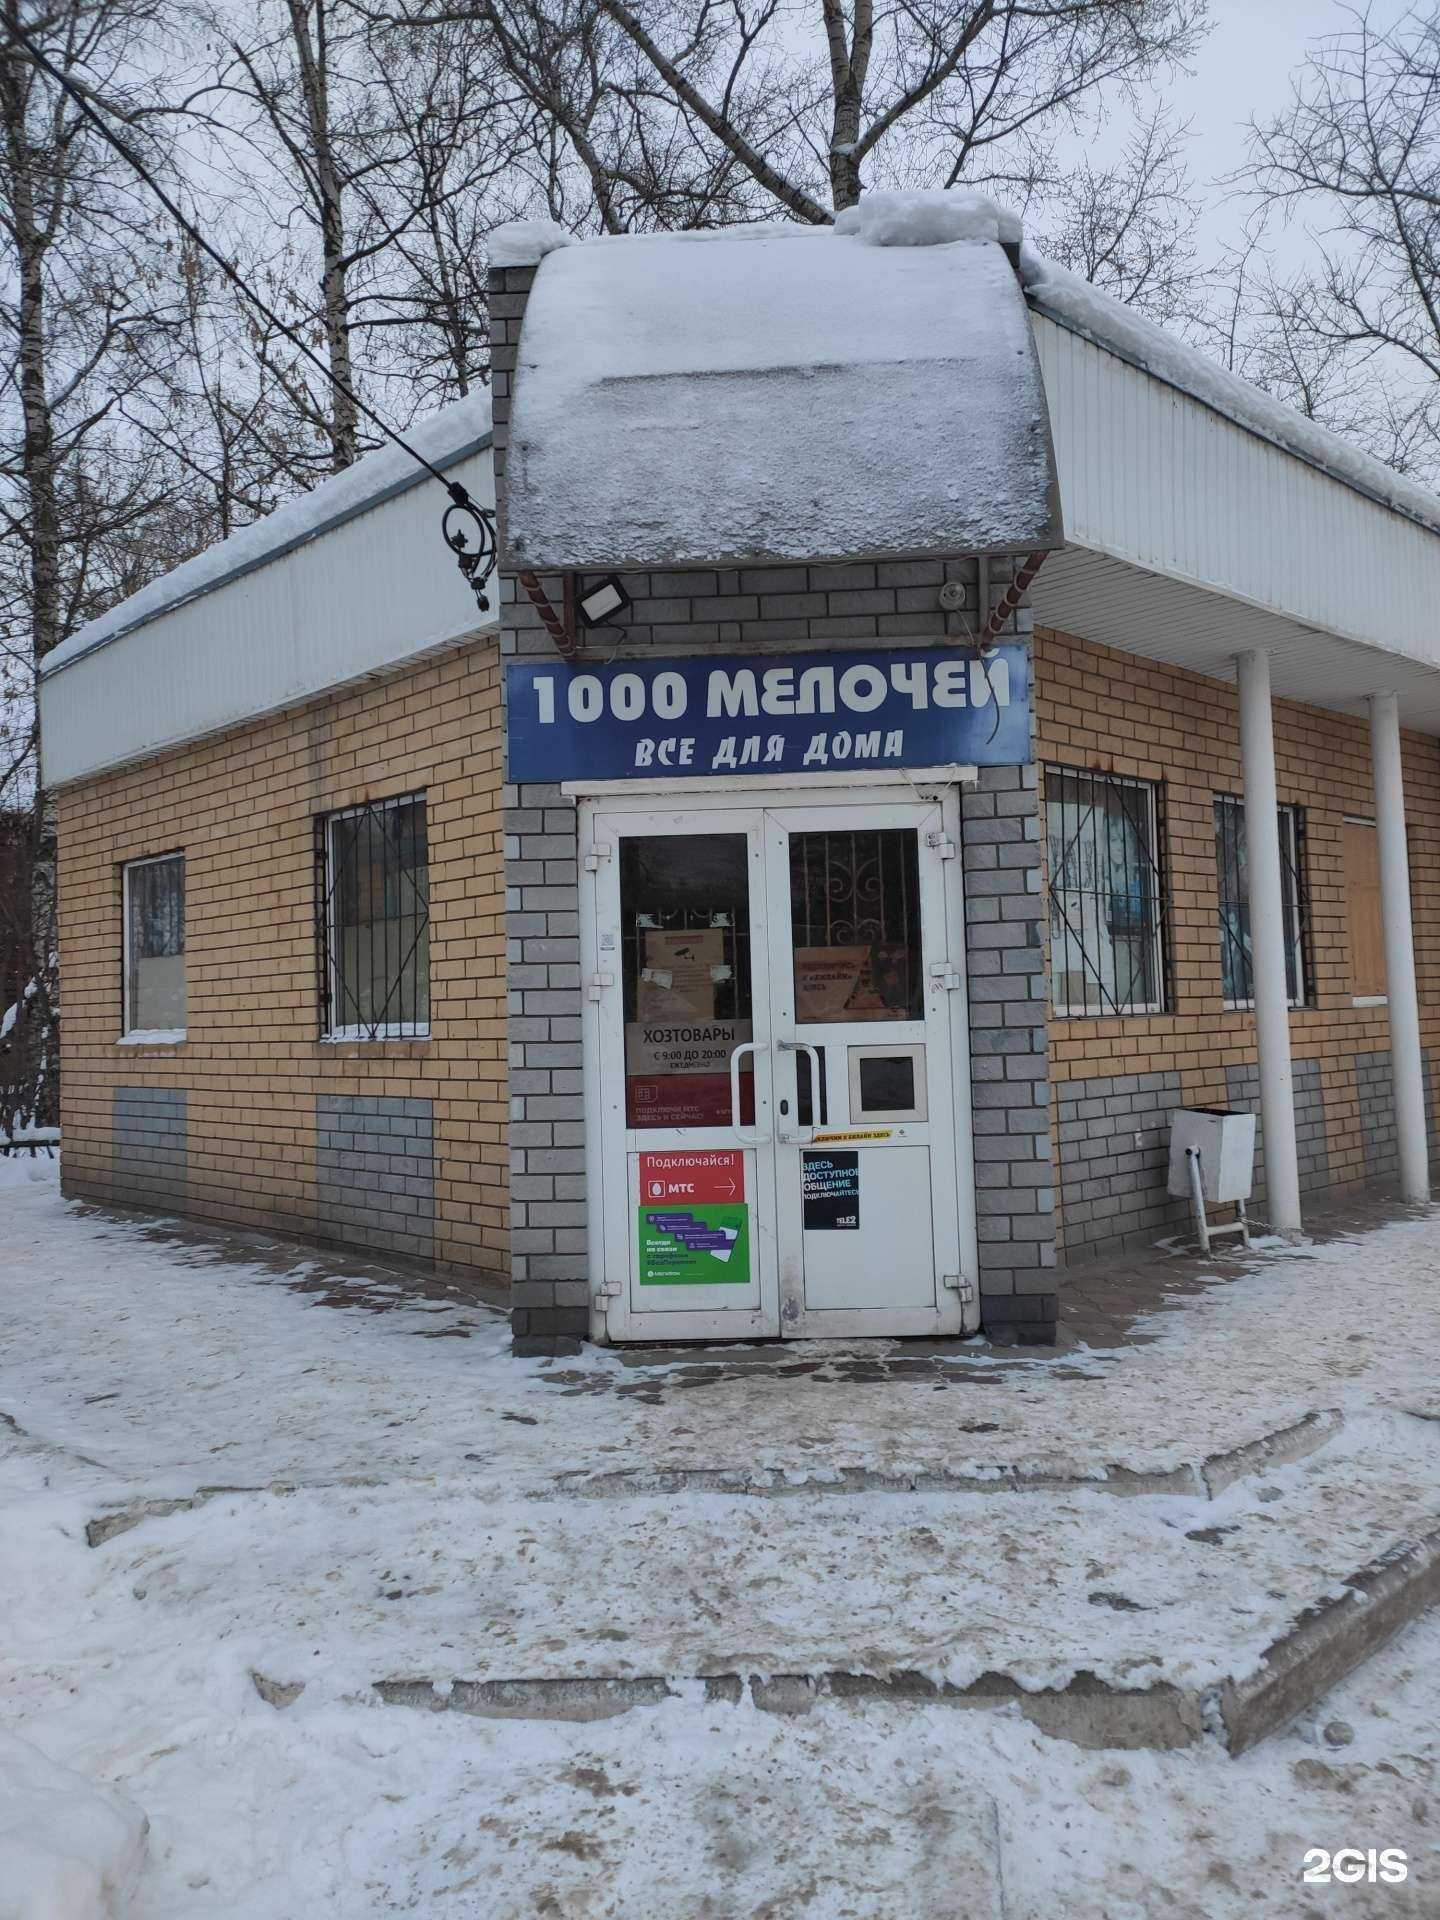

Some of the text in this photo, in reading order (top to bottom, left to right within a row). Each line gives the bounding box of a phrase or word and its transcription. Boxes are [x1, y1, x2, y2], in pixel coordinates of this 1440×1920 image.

[533, 648, 1010, 723] 1000 МЕЛОЧЕЙ
[635, 729, 905, 769] ВСЕ ДЛЯ ДОМА
[643, 1027, 735, 1044] ХОЗТОВАРЫ
[662, 1051, 682, 1060] 9:00
[684, 1050, 699, 1061] ДО
[702, 1049, 726, 1059] 20:00
[647, 1154, 735, 1169] Подключайся!
[802, 1161, 834, 1171] ЗДЕСЬ
[668, 1183, 695, 1193] МТС
[803, 1179, 851, 1192] ОБЩЕНИЕ
